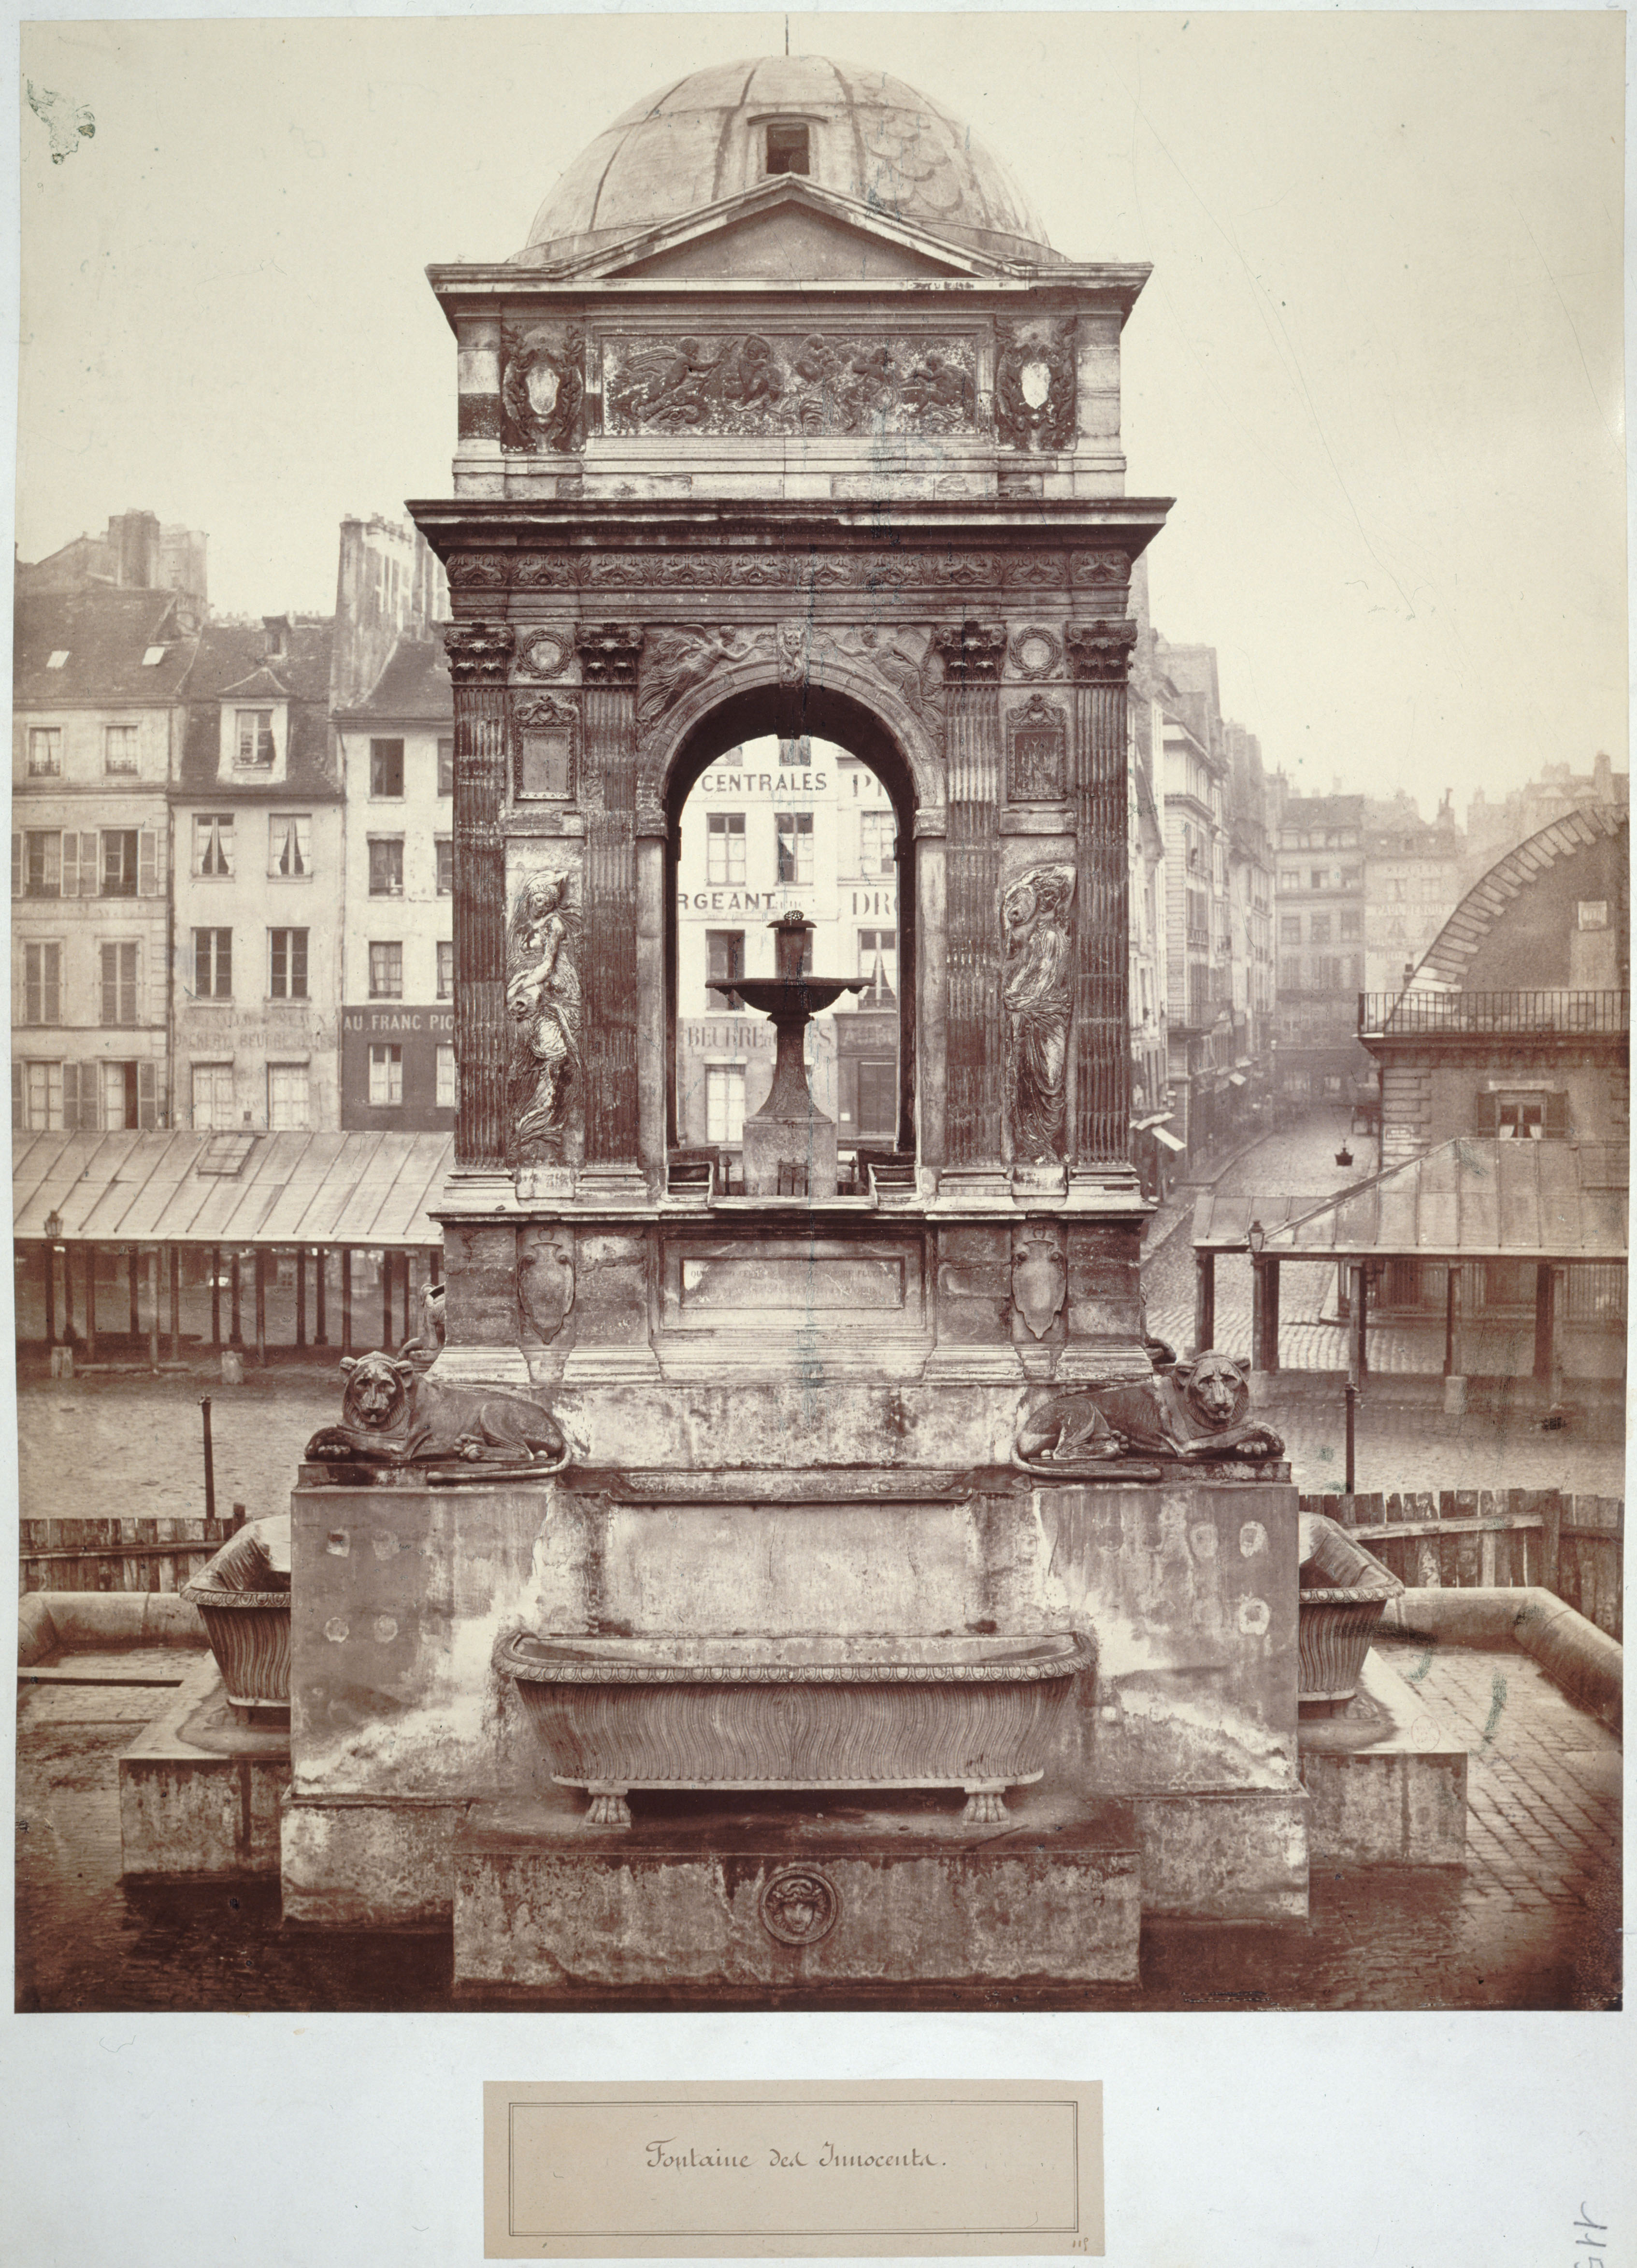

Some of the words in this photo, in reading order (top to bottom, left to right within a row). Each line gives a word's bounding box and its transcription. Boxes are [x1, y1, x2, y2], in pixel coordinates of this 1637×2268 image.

[702, 773, 827, 791] CENTRALES
[344, 1016, 362, 1030] AU
[372, 1015, 421, 1030] FRANC
[688, 1026, 764, 1048] BEURRE
[646, 2136, 756, 2170] Fontaine
[769, 2149, 807, 2168] des
